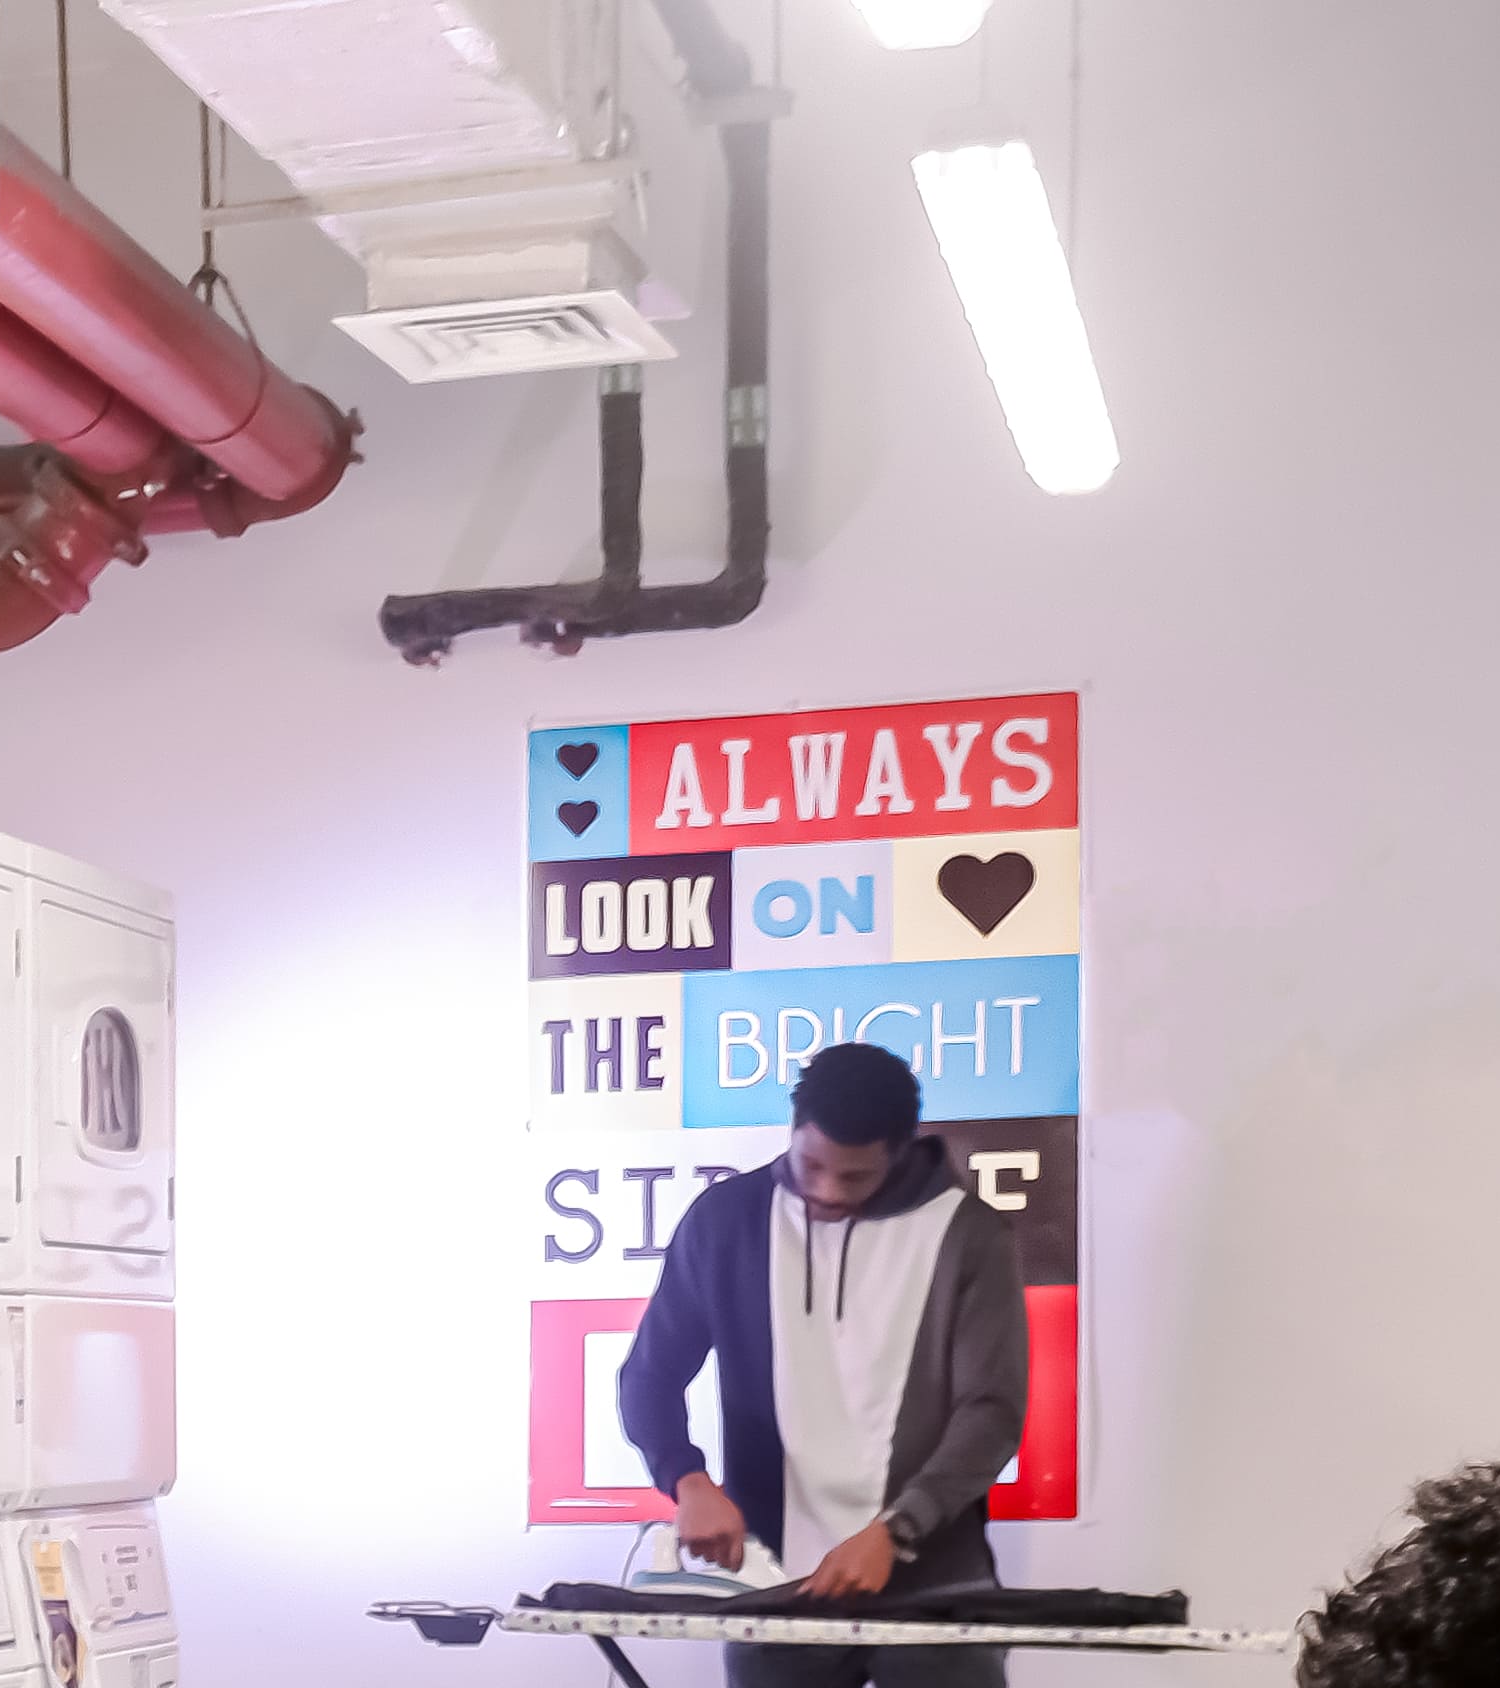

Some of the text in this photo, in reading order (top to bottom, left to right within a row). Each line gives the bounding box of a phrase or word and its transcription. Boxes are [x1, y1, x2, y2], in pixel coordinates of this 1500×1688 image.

[654, 717, 1053, 829] ALWAYS
[545, 874, 876, 956] LOOK ON
[541, 1015, 665, 1095] THE
